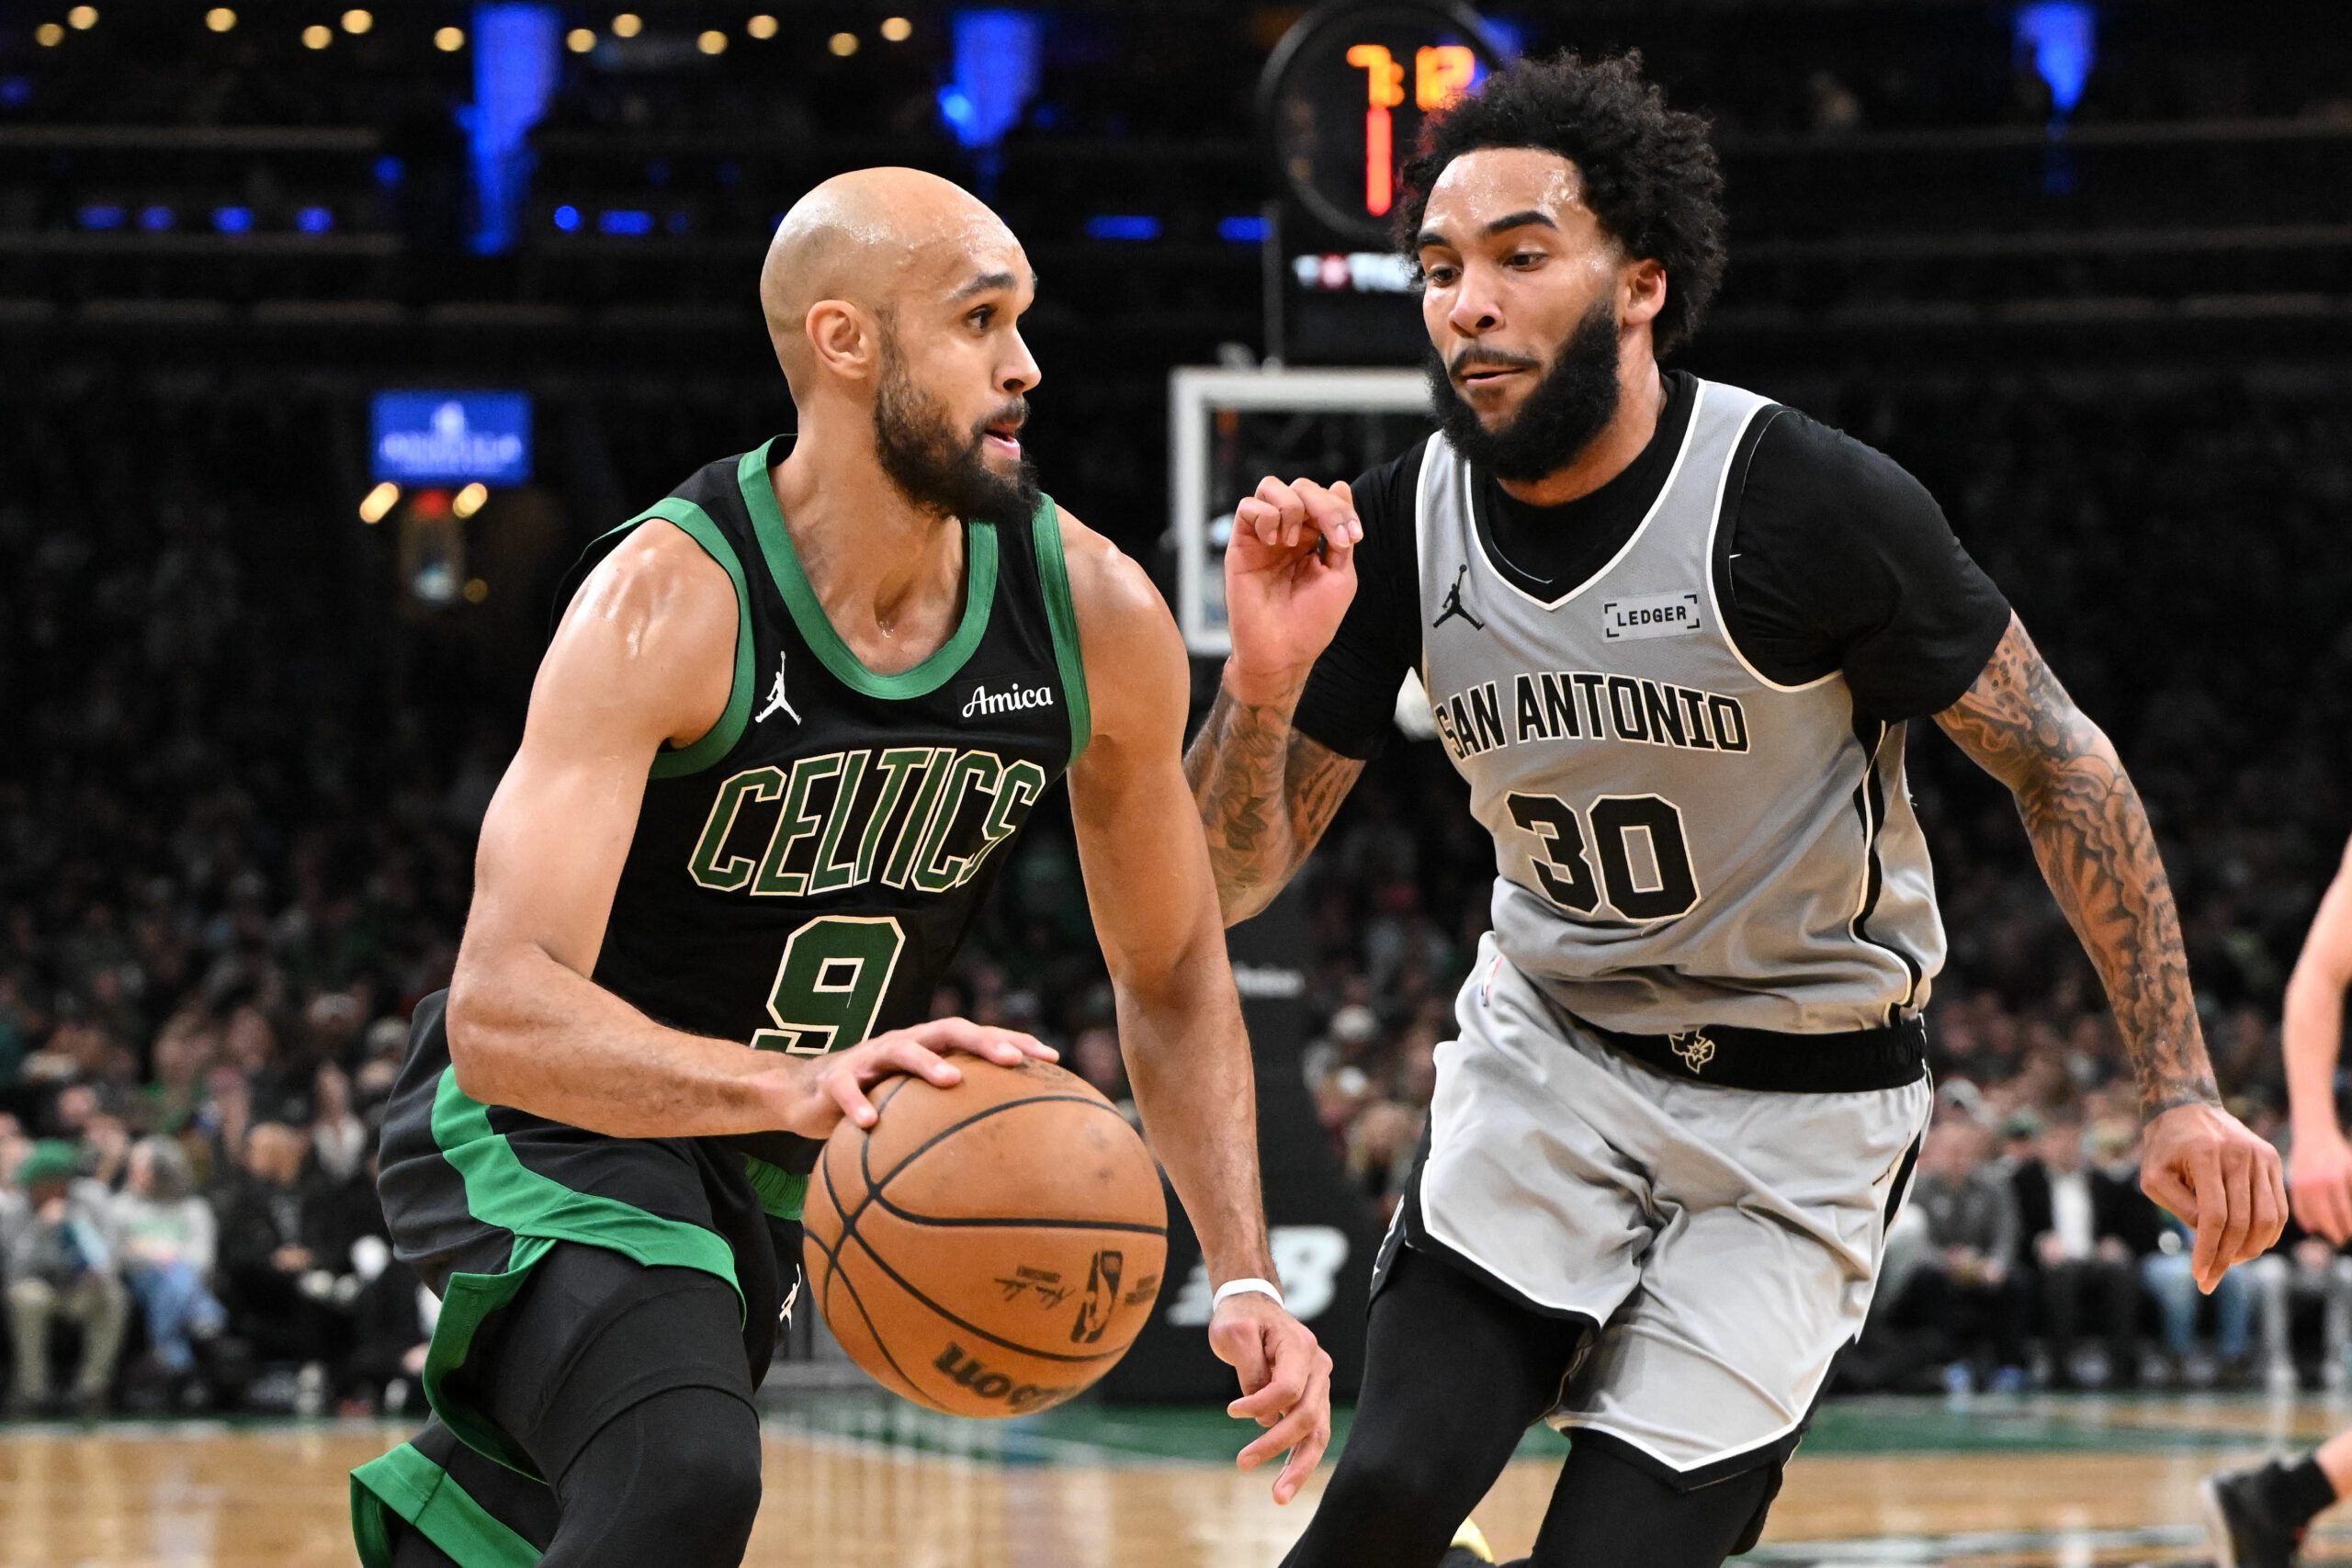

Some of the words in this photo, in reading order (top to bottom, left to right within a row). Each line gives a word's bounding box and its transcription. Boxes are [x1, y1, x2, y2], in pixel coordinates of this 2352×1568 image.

[1617, 605, 1687, 626] LEDGER
[962, 682, 1054, 718] Amica
[1433, 680, 1508, 760] SAN
[1514, 671, 1750, 754] ANTONIO
[687, 747, 1046, 897] CELTICS
[1504, 790, 1702, 923] 30
[750, 915, 907, 1055] 9
